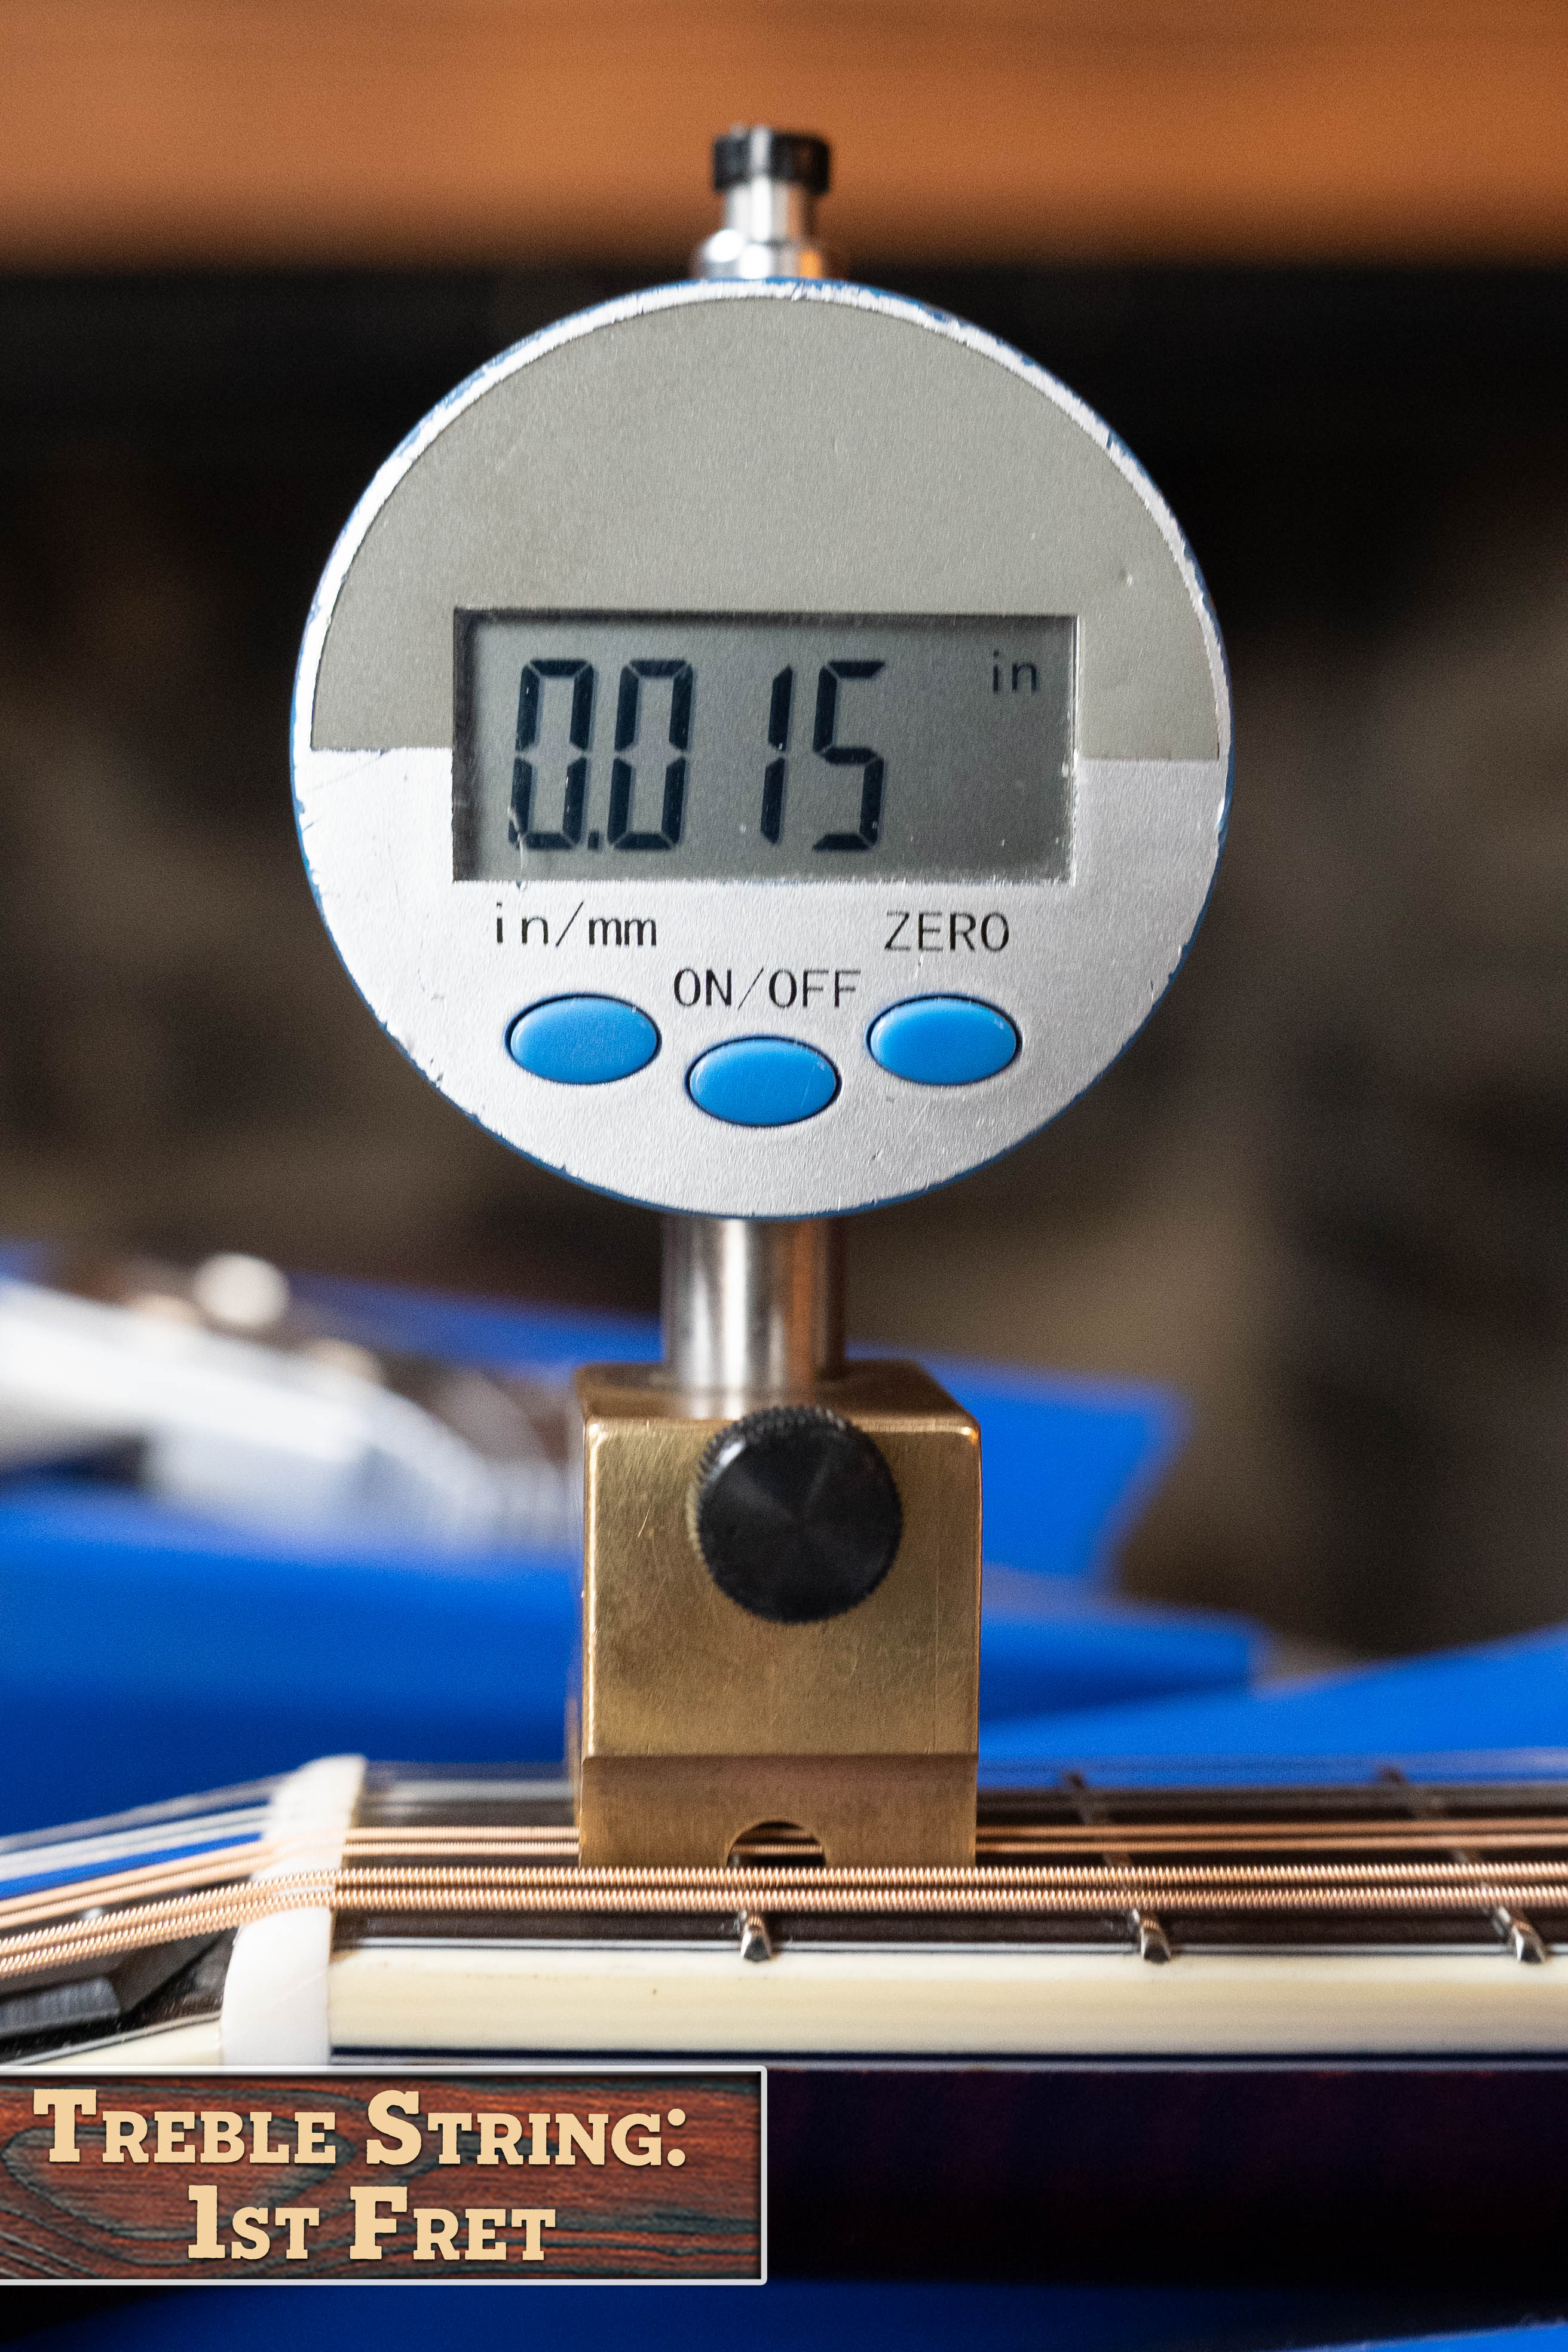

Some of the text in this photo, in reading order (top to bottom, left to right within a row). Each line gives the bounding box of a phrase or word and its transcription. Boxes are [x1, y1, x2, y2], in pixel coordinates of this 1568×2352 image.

[991, 650, 1039, 693] in
[508, 658, 885, 851] 0.015
[495, 902, 657, 948] in/mm
[884, 911, 1010, 951] ZERO
[673, 968, 862, 1011] ON/OFF
